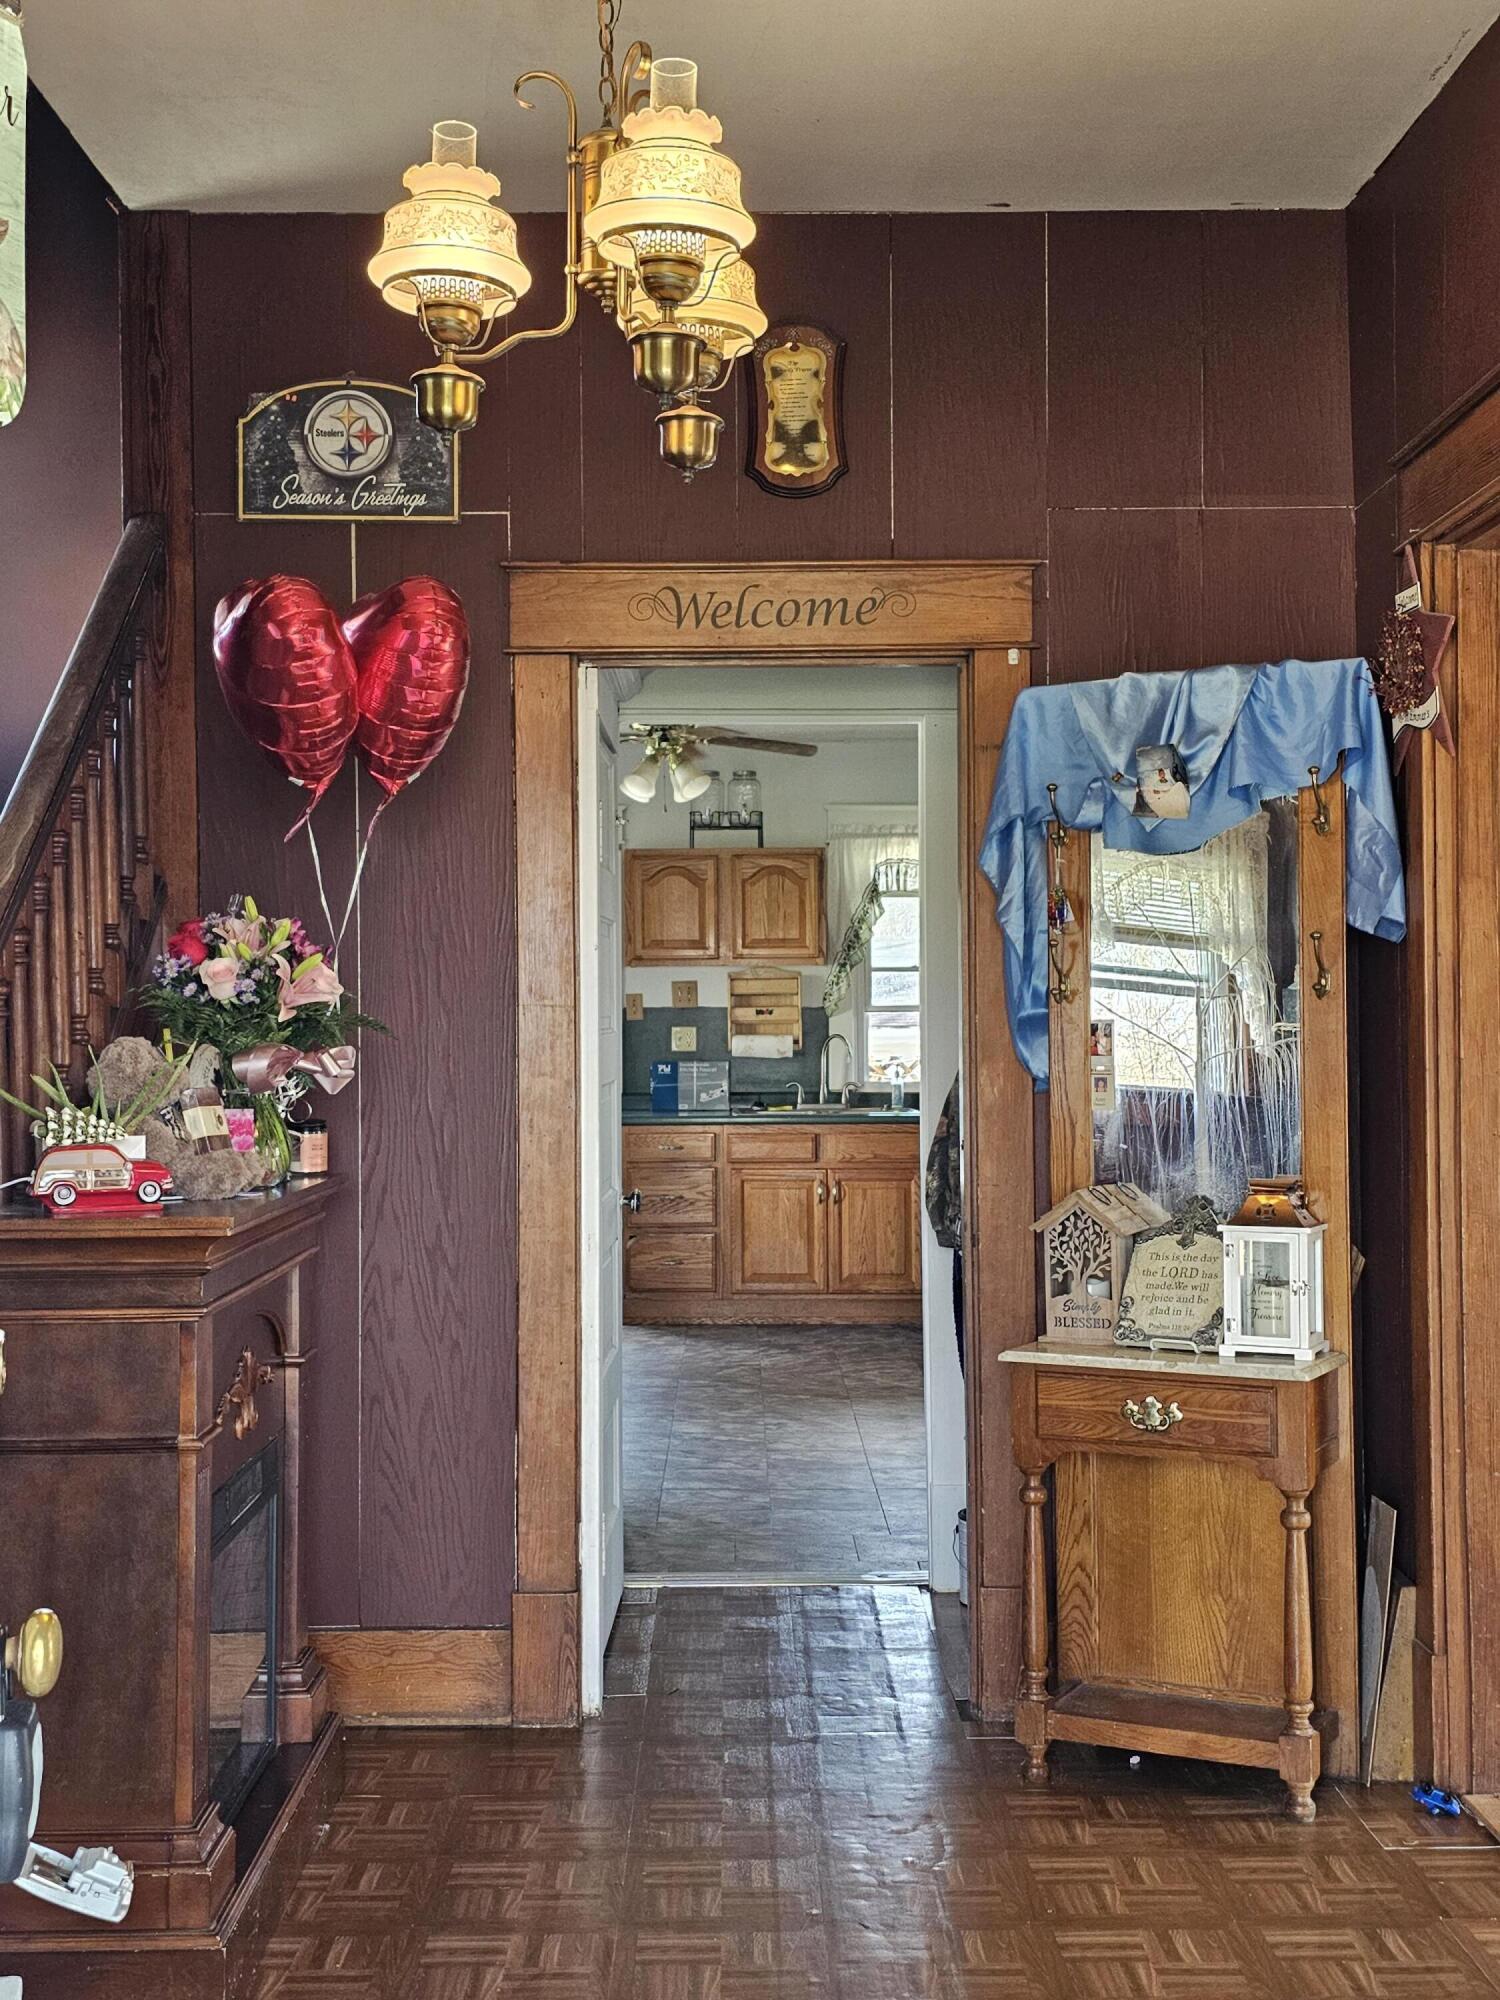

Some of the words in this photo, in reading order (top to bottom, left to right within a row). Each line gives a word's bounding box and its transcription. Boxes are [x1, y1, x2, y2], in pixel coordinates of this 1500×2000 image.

[315, 428, 345, 437] Steelers
[272, 473, 346, 509] Season's
[351, 474, 428, 517] Greetings
[650, 583, 886, 630] Welcome
[1149, 1252, 1169, 1261] This
[1172, 1253, 1180, 1261] is
[1183, 1253, 1198, 1262] the
[1200, 1253, 1220, 1265] day
[1142, 1267, 1158, 1277] the
[1160, 1266, 1199, 1279] LORD
[1201, 1269, 1219, 1279] has
[1191, 1283, 1210, 1292] will
[1141, 1293, 1174, 1304] rejoice
[1176, 1294, 1195, 1304] and
[1197, 1295, 1209, 1304] be
[1062, 1299, 1102, 1315] Simply
[1149, 1305, 1170, 1316] glad
[1172, 1307, 1182, 1316] in
[1054, 1316, 1112, 1329] BLESSED
